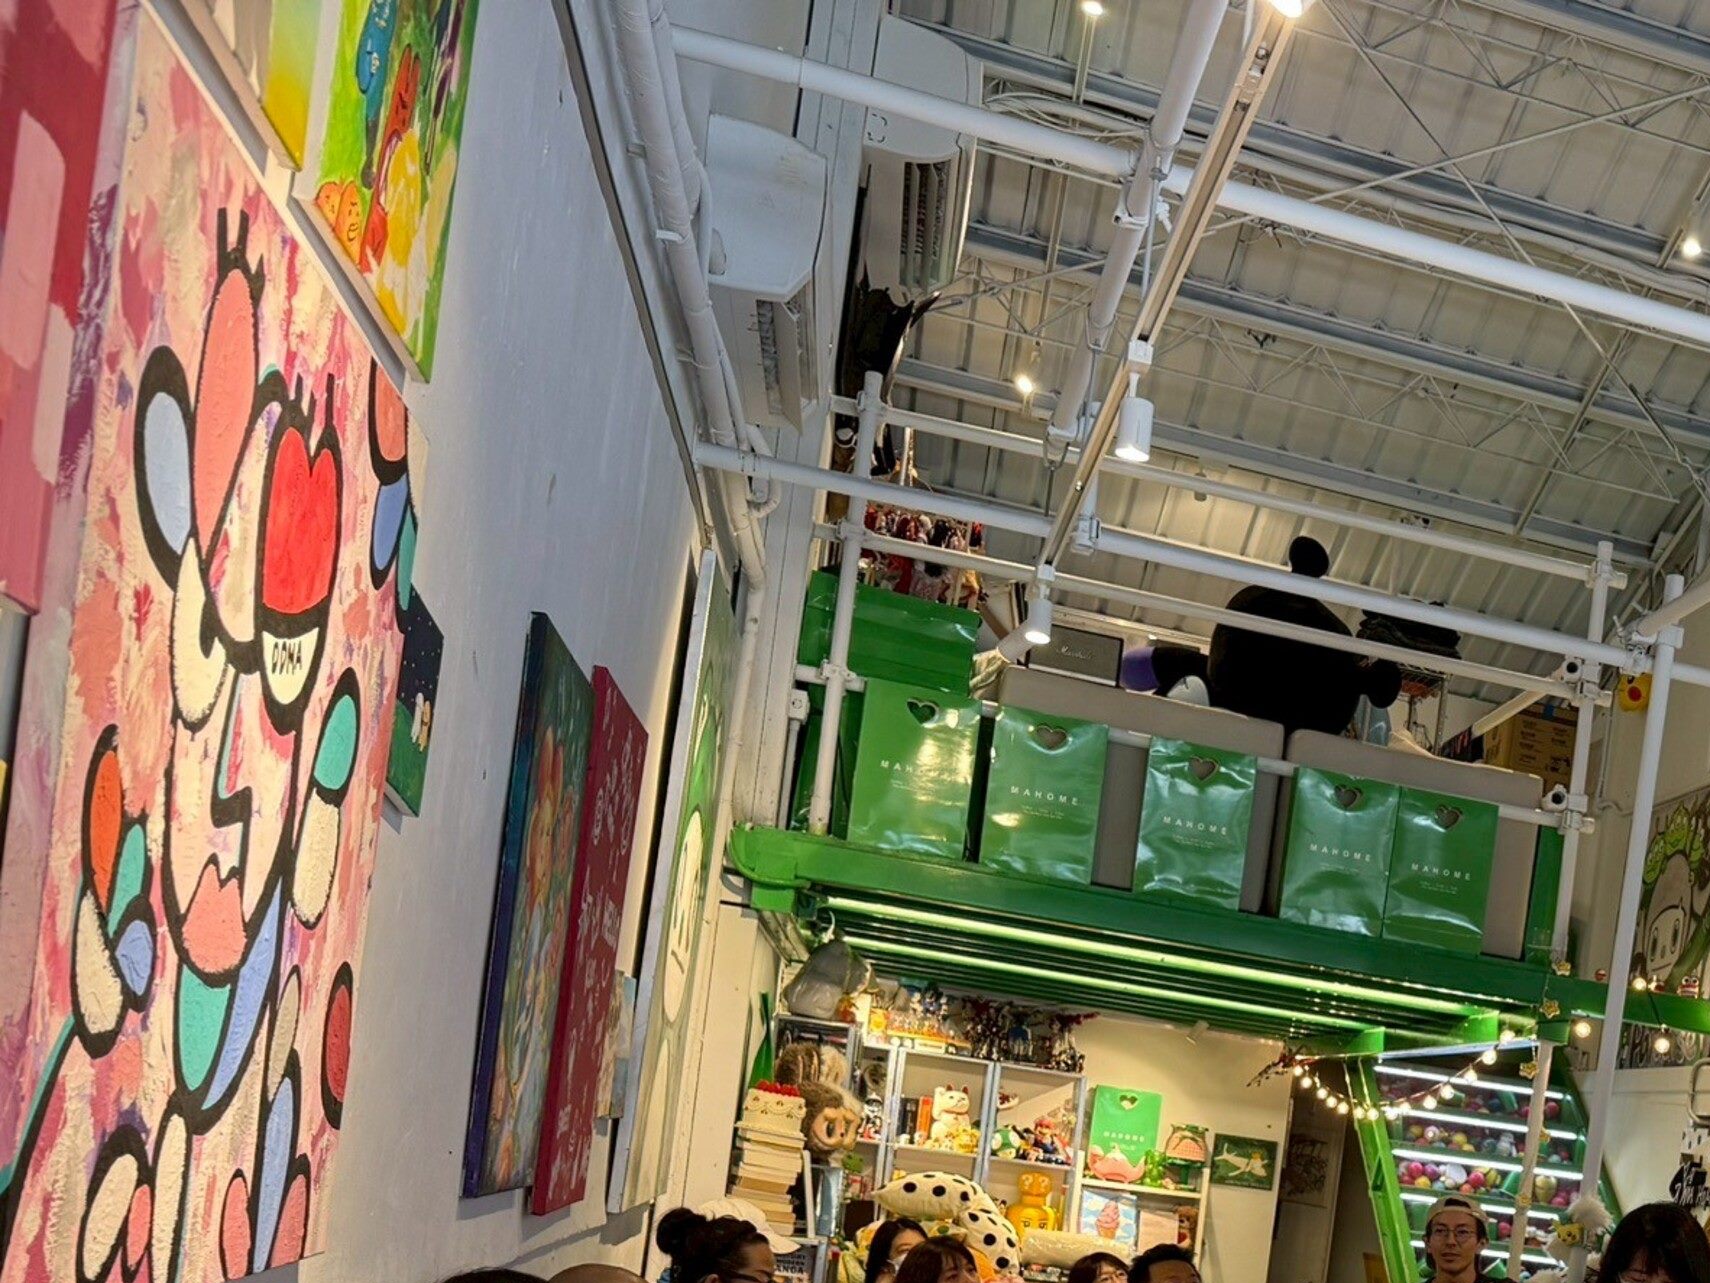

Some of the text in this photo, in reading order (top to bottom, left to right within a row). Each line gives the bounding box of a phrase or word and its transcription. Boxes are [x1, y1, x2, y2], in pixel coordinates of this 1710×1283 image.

[1010, 786, 1079, 806] MAHOME
[1163, 816, 1227, 836] MAHOME
[1310, 843, 1371, 862] MAHOME
[1411, 863, 1471, 881] MAHOME
